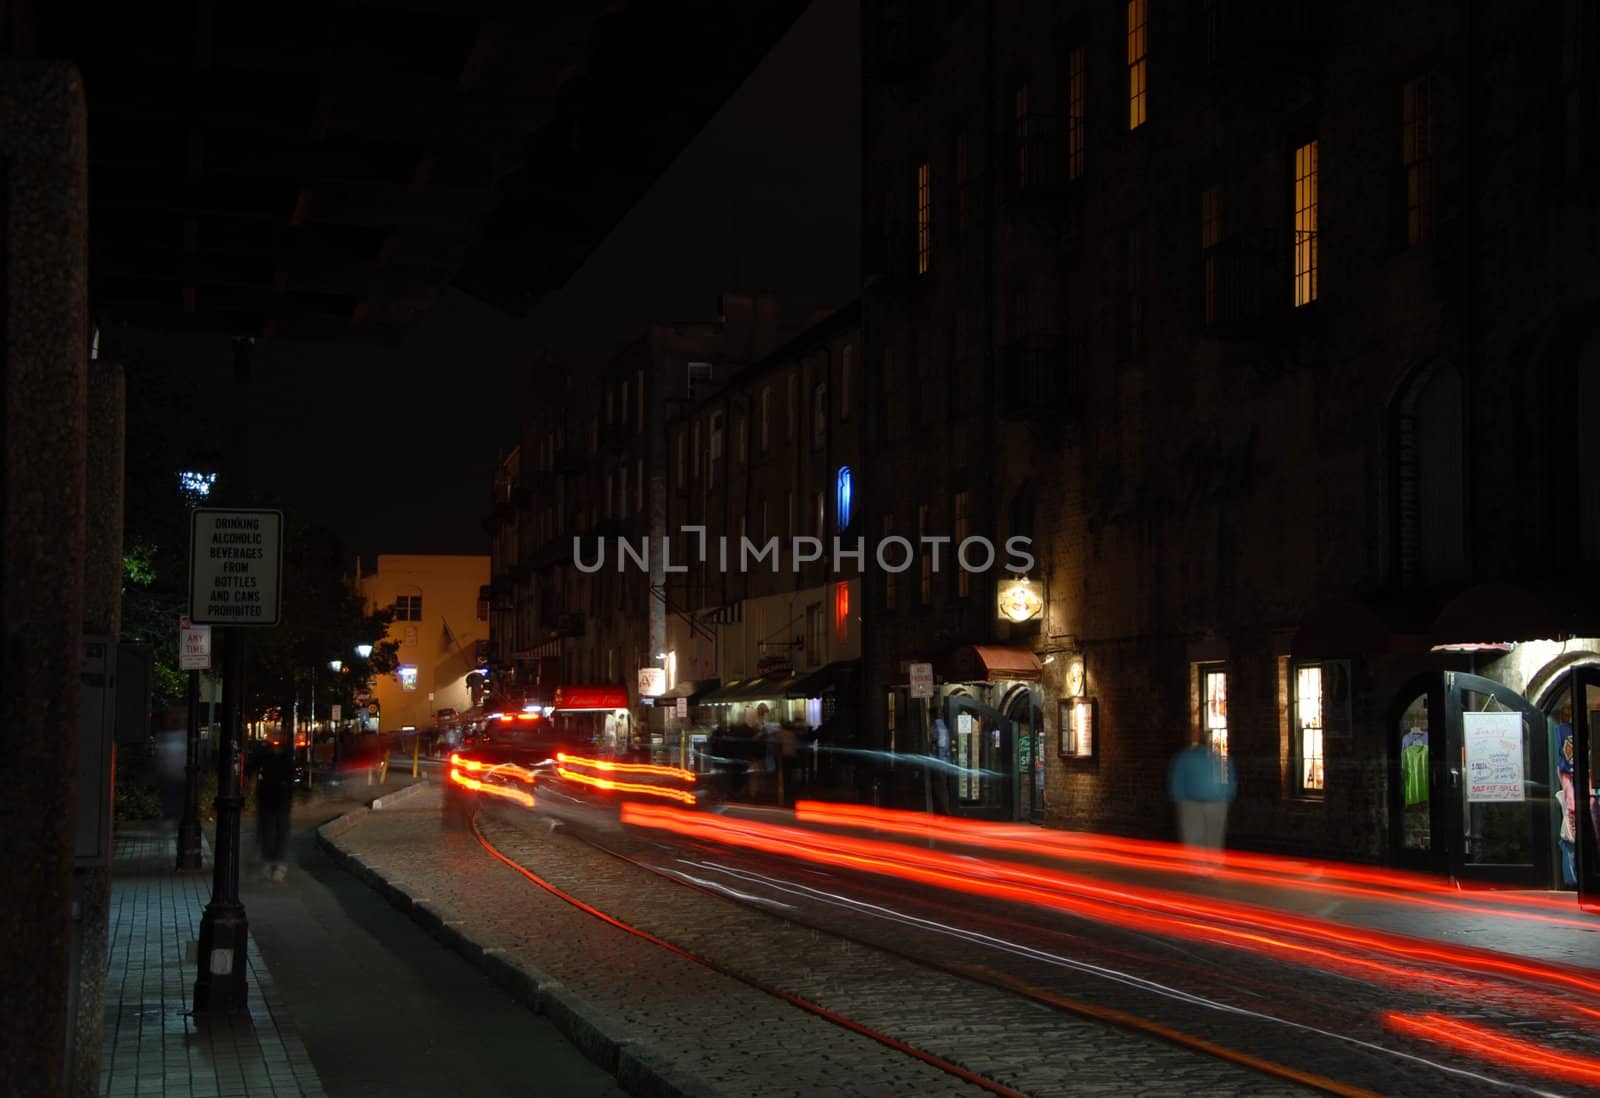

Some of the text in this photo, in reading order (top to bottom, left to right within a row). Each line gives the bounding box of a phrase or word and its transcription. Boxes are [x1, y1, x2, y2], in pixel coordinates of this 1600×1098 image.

[215, 518, 259, 529] DRINKING
[212, 533, 262, 544] ALCOHOLIC
[210, 547, 263, 559] BEVERAGES
[223, 562, 249, 573] FROM
[214, 576, 257, 587] BOTTLES
[210, 591, 260, 602] AND CANS
[208, 605, 262, 617] PROHIBITED
[187, 633, 203, 642] ANY
[184, 645, 205, 654] TIME
